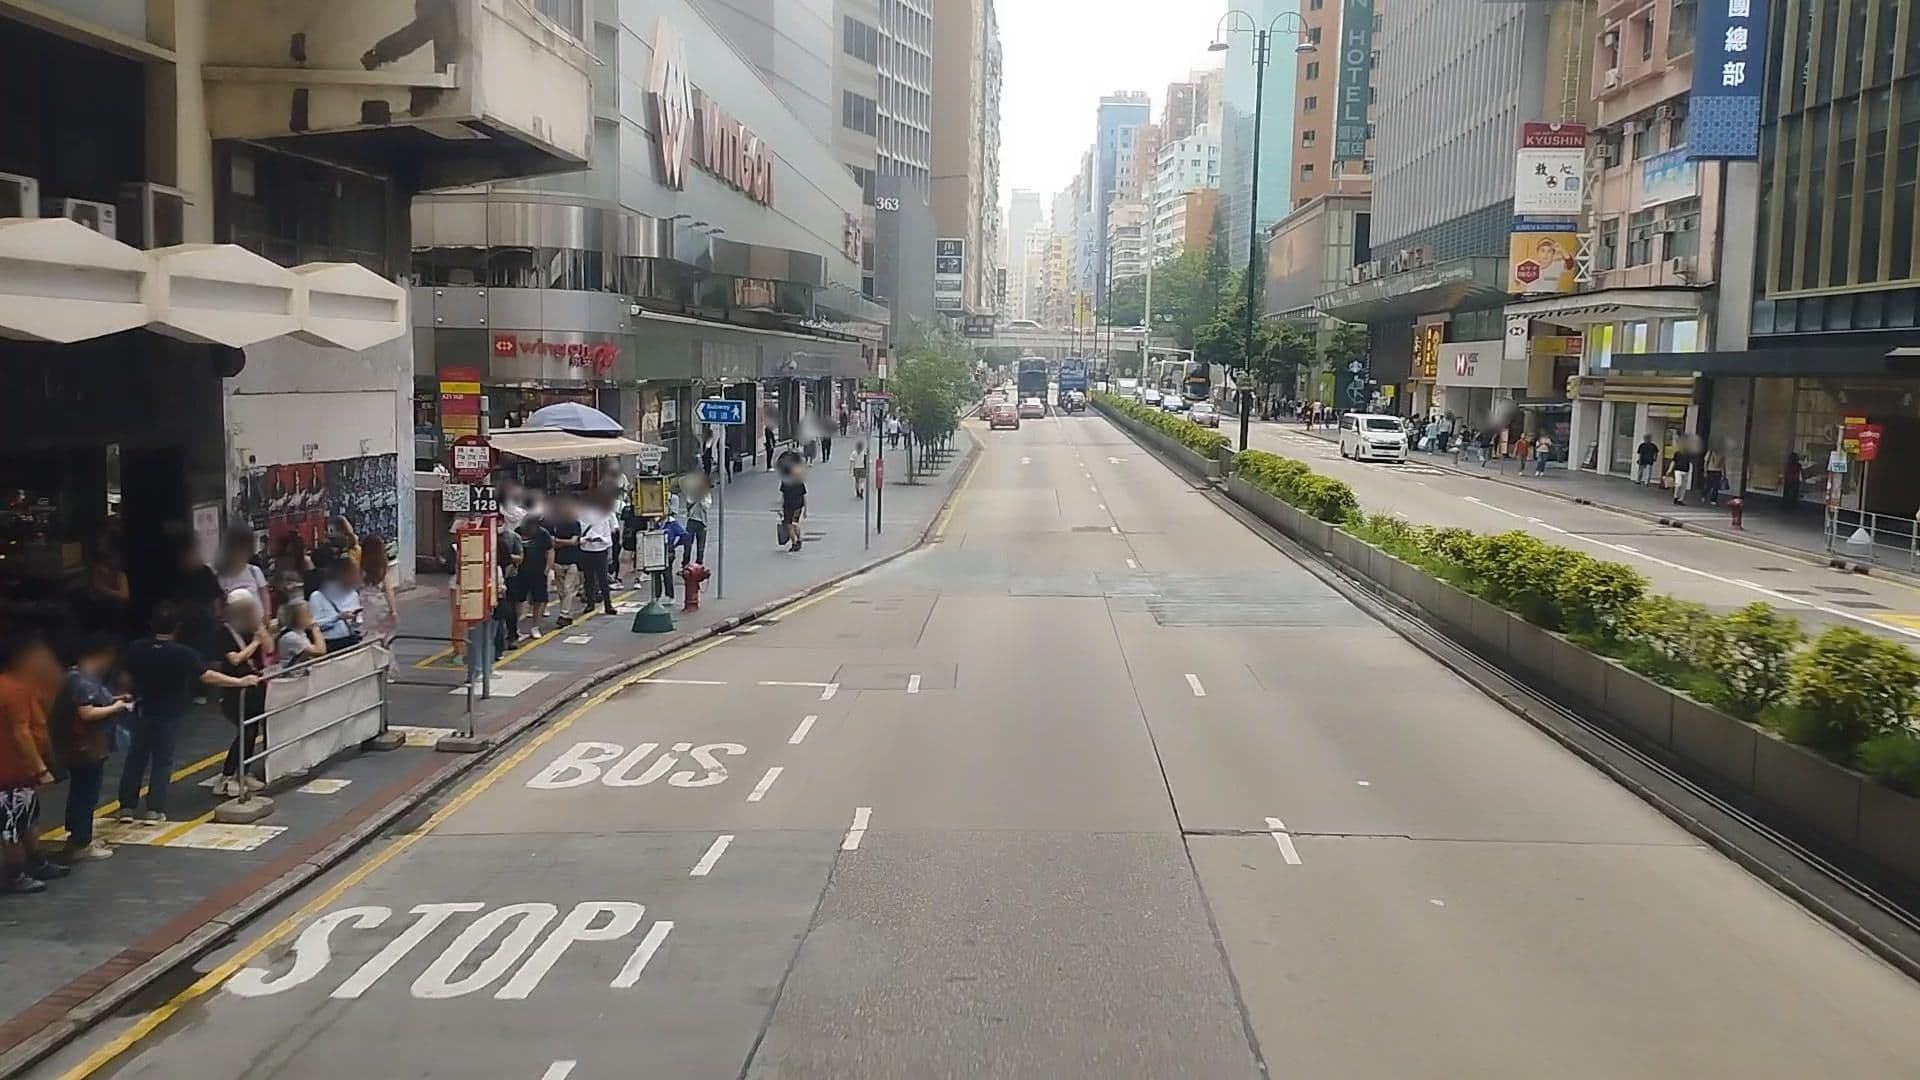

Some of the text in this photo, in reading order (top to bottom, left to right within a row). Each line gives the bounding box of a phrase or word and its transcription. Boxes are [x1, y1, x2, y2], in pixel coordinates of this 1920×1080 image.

[1345, 29, 1366, 121] HOTEL
[1526, 135, 1583, 145] KYUSHIN
[876, 196, 900, 211] 363
[473, 486, 496, 498] YT
[473, 499, 497, 510] 128
[526, 742, 747, 790] BUS
[223, 901, 647, 1001] STOP
